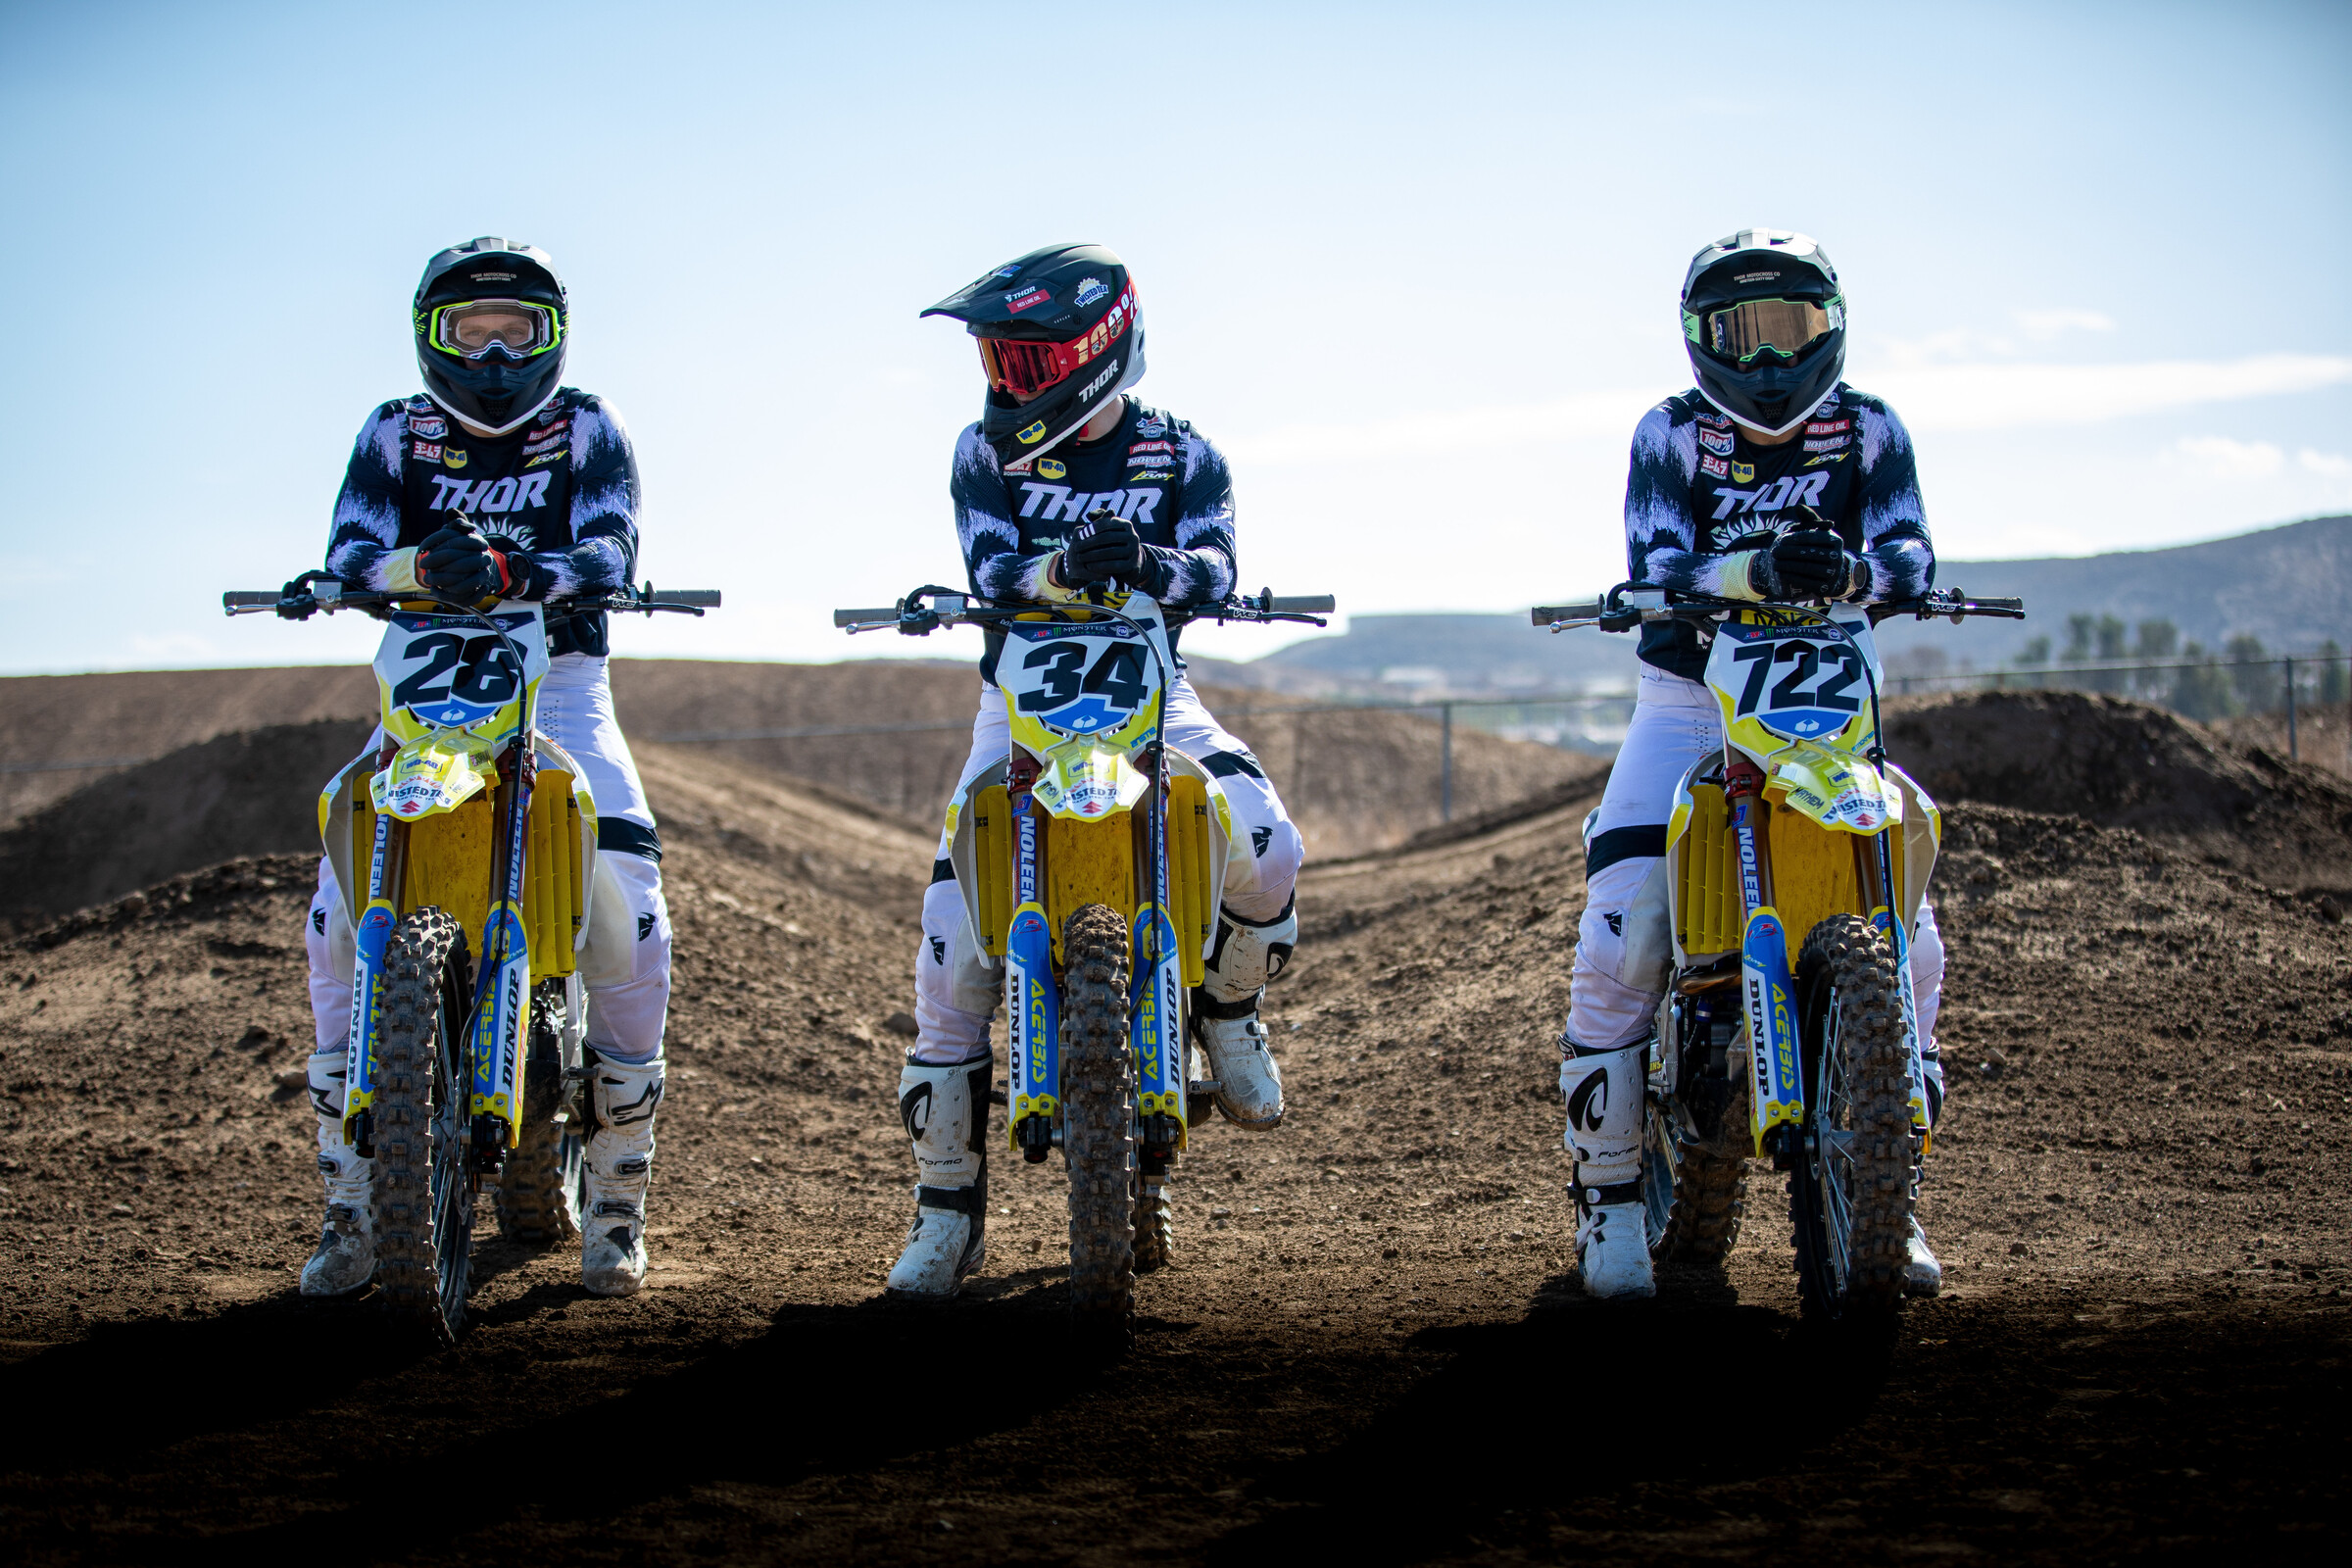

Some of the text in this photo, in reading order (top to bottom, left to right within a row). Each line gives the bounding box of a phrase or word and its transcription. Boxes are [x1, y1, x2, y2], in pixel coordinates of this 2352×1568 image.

[1011, 285, 1037, 300] THOR
[1075, 287, 1099, 307] TWISTED
[1096, 284, 1108, 294] TEA
[1073, 284, 1139, 366] 100%
[1078, 359, 1119, 403] THOR
[415, 421, 444, 435] 100%
[1019, 422, 1045, 440] WD-40
[1133, 442, 1172, 454] RED LINE OIL
[1704, 433, 1731, 452] 100%
[1804, 436, 1845, 448] NOLEEN
[1807, 421, 1846, 433] RED LINE OIL
[415, 441, 442, 459] ヨシムラ
[446, 450, 466, 462] WD-40
[1041, 460, 1064, 472] WD-40
[1702, 454, 1728, 474] ヨシムラ
[1734, 463, 1752, 475] WD-40
[429, 469, 553, 514] THOR
[1018, 481, 1163, 524] THOR
[1018, 641, 1149, 712] 34
[1734, 639, 1863, 717] 722
[406, 759, 439, 769] WD-40
[1792, 786, 1825, 810] MAYHEM
[369, 813, 389, 898] NOLEEN
[1020, 815, 1035, 903] NOLEEN
[1738, 826, 1761, 919] NOLEEN
[348, 968, 364, 1084] DUNLOP
[501, 967, 518, 1093] DUNLOP
[1009, 973, 1020, 1090] DUNLOP
[1031, 978, 1046, 1083] ACERBIS
[1164, 966, 1180, 1089] DUNLOP
[1748, 978, 1770, 1097] DUNLOP
[1771, 983, 1794, 1090] ACERBIS
[1901, 970, 1923, 1093] DUNLOP
